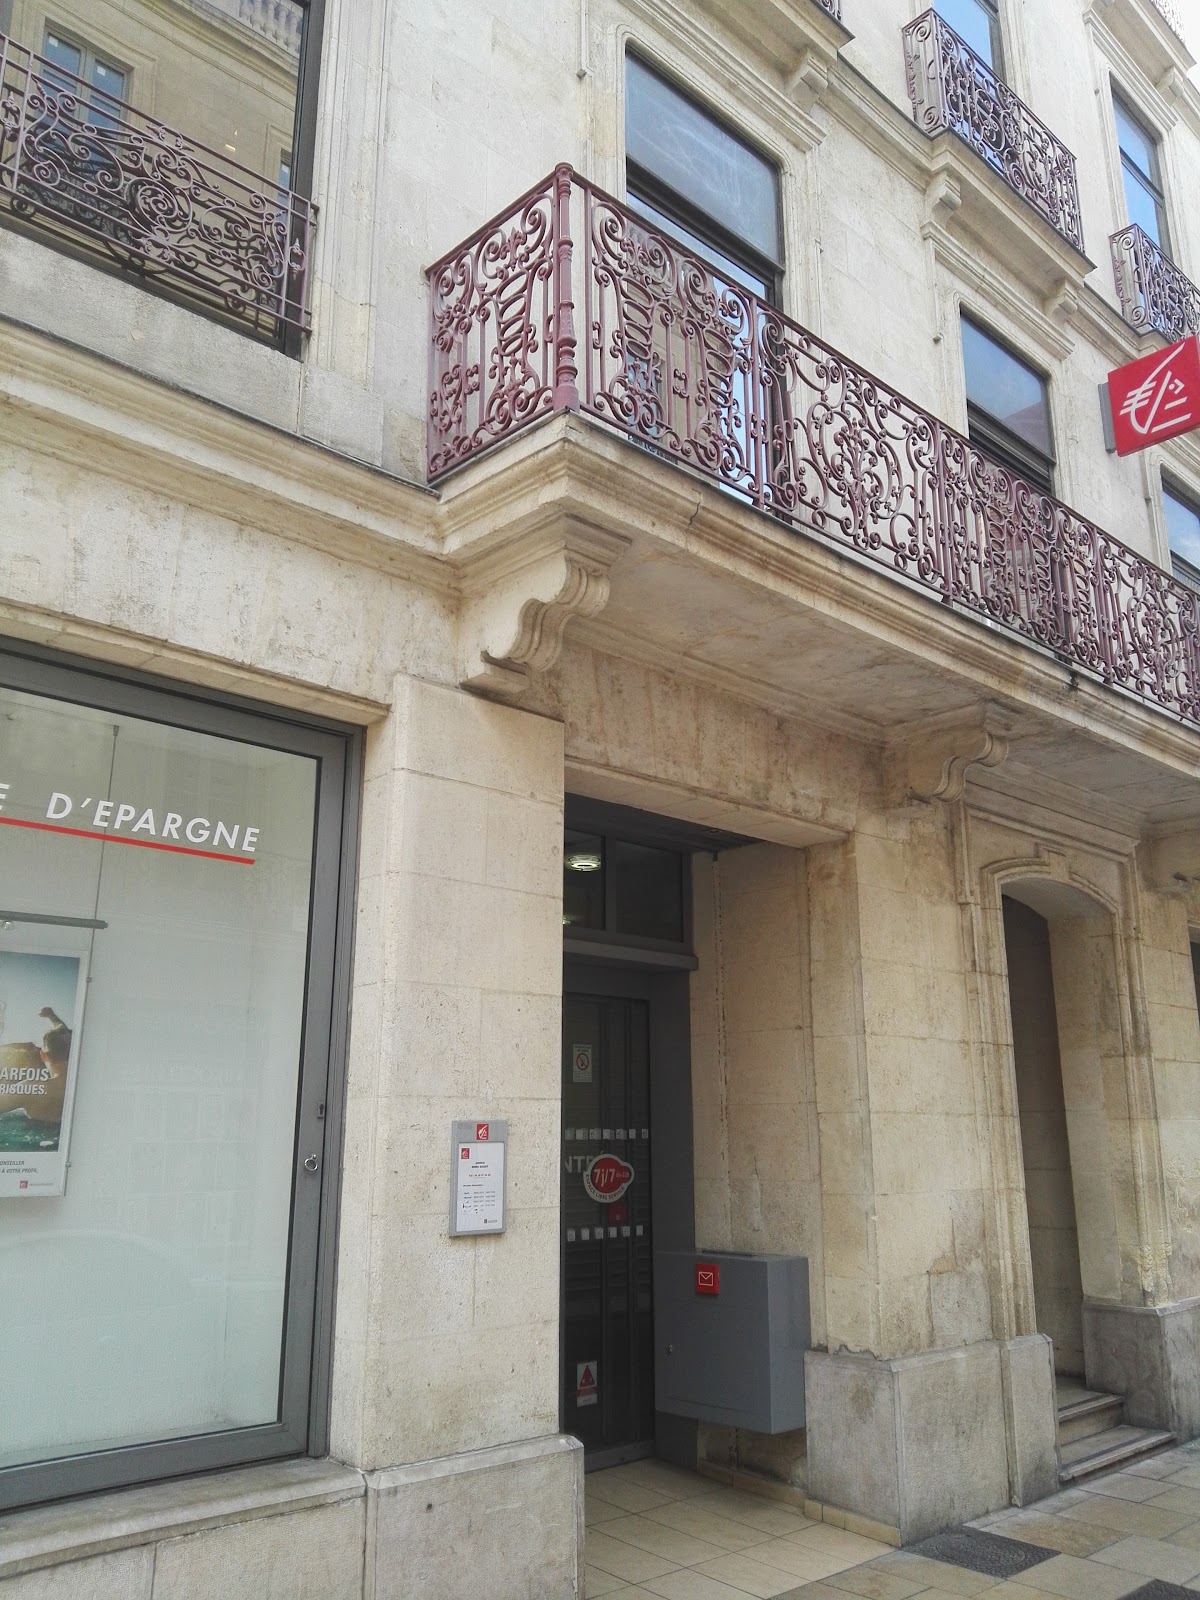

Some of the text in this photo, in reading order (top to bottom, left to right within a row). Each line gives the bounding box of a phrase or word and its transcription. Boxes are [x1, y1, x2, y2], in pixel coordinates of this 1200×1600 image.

[46, 792, 260, 852] D'EPARGNE
[0, 1067, 49, 1082] ARFOIS
[0, 1083, 47, 1095] RISQUES.
[594, 1168, 616, 1188] 7j/7
